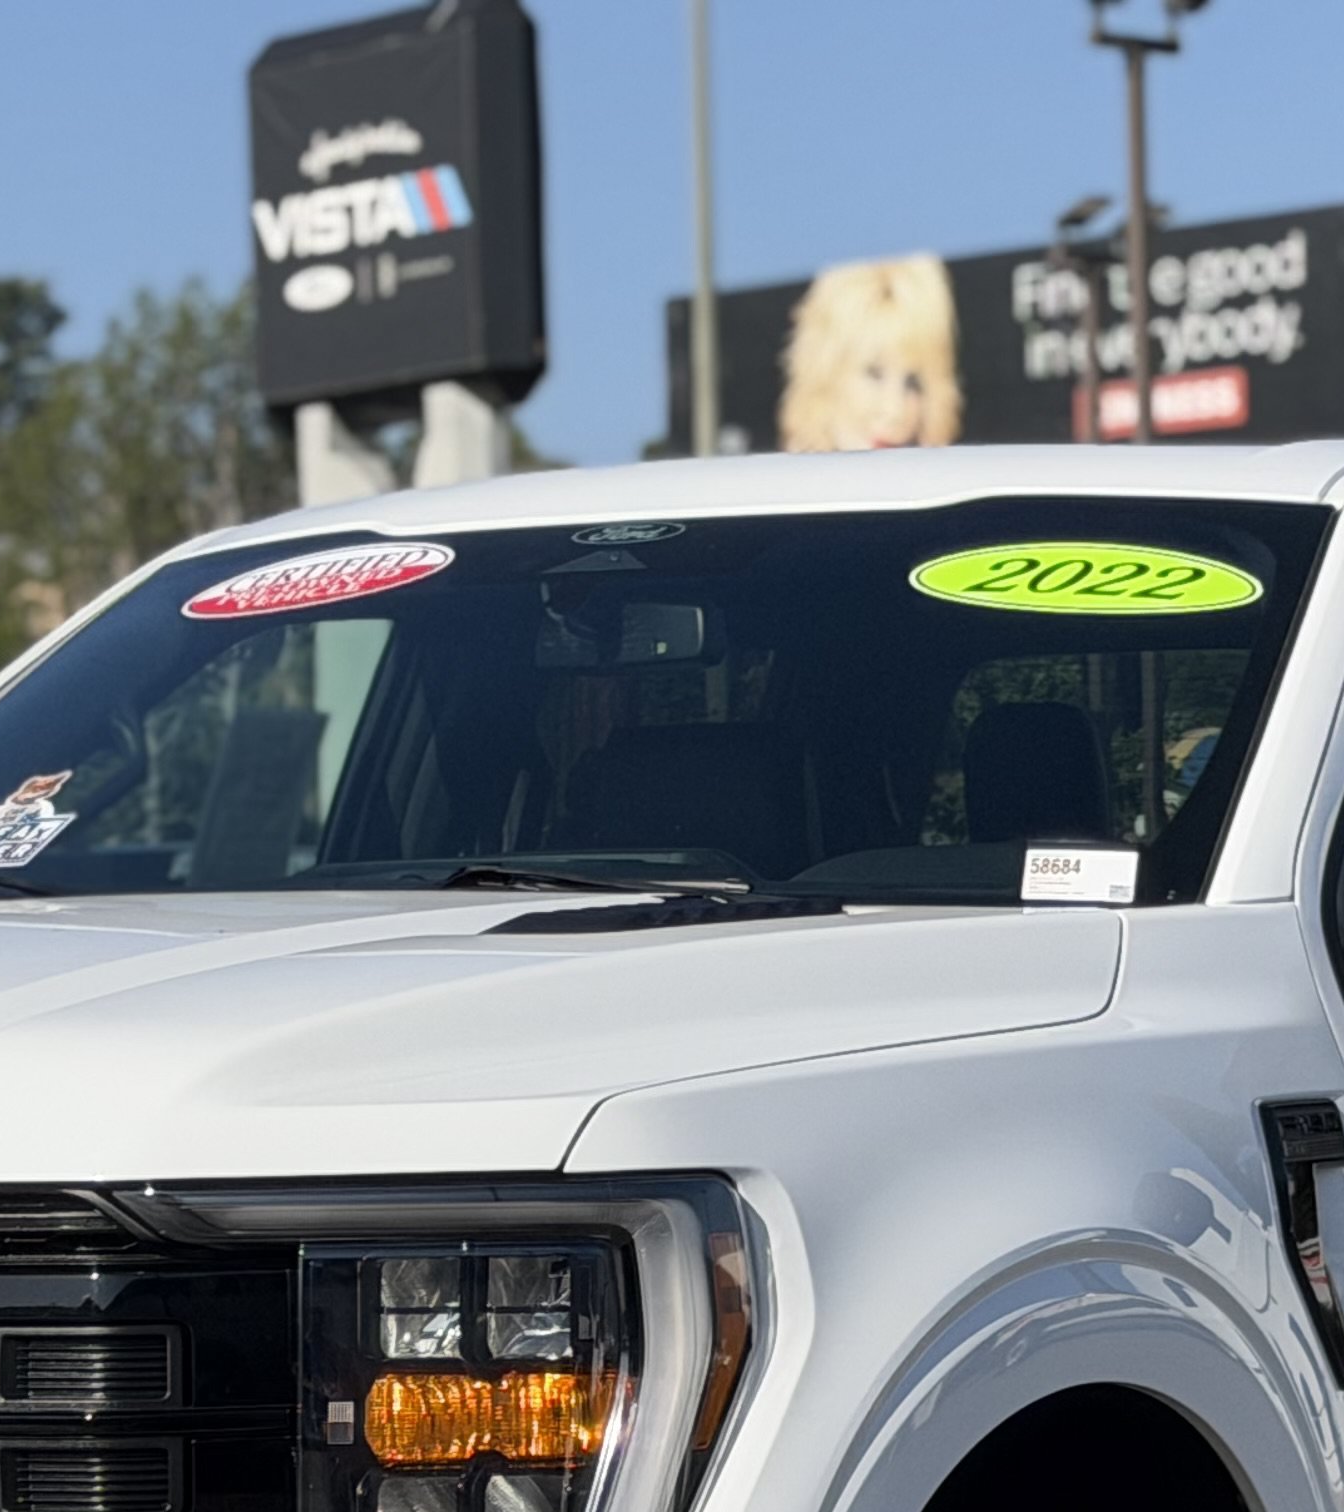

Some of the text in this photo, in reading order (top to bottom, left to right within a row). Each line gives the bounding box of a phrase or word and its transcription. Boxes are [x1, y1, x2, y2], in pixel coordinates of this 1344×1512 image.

[253, 176, 416, 262] VISTA
[1012, 256, 1097, 323] Fin
[1187, 228, 1307, 313] good
[225, 549, 430, 595] CERTIFIED
[962, 557, 1207, 601] 2022
[1029, 857, 1082, 875] 58684
